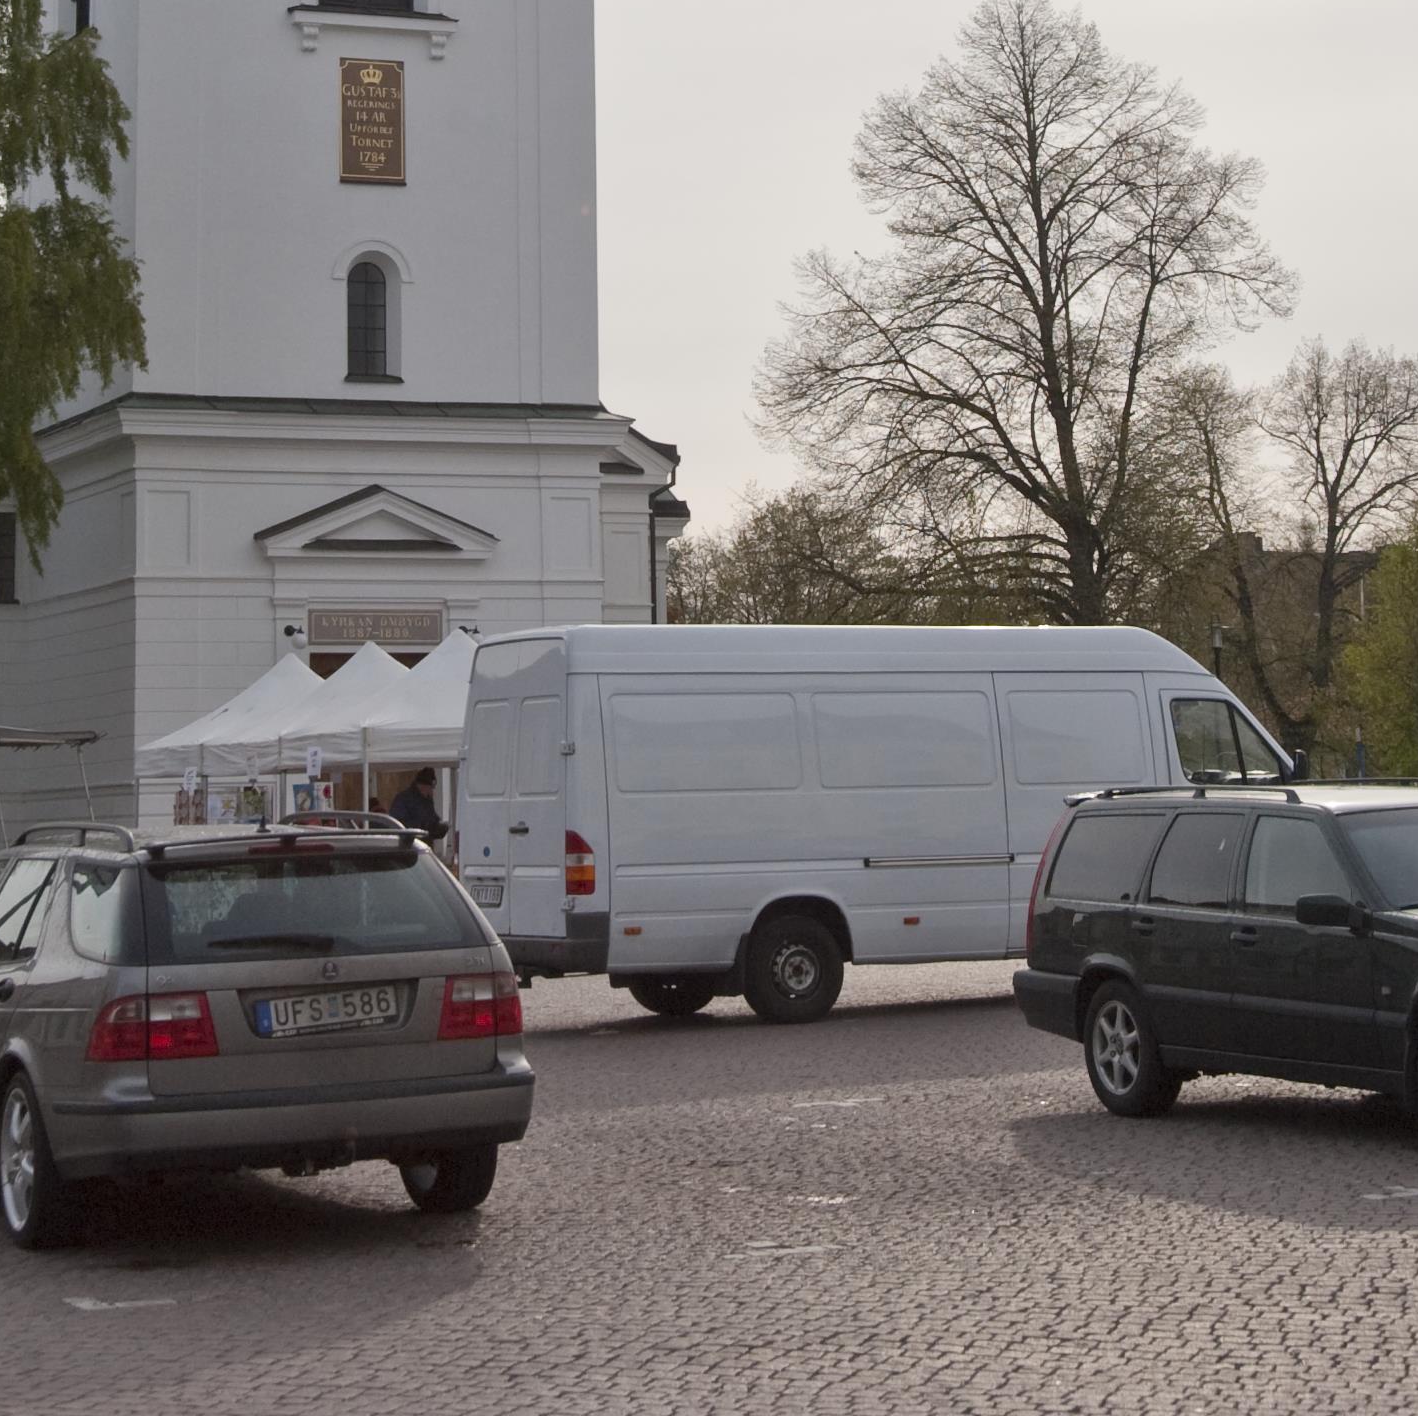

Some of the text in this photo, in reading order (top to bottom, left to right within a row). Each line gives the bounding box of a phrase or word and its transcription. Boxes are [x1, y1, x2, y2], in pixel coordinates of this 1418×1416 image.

[356, 111, 368, 122] 14
[350, 135, 394, 148] TORNET
[359, 151, 387, 163] 1784
[321, 616, 374, 627] KYRKAN
[274, 989, 390, 1026] UFS 586
